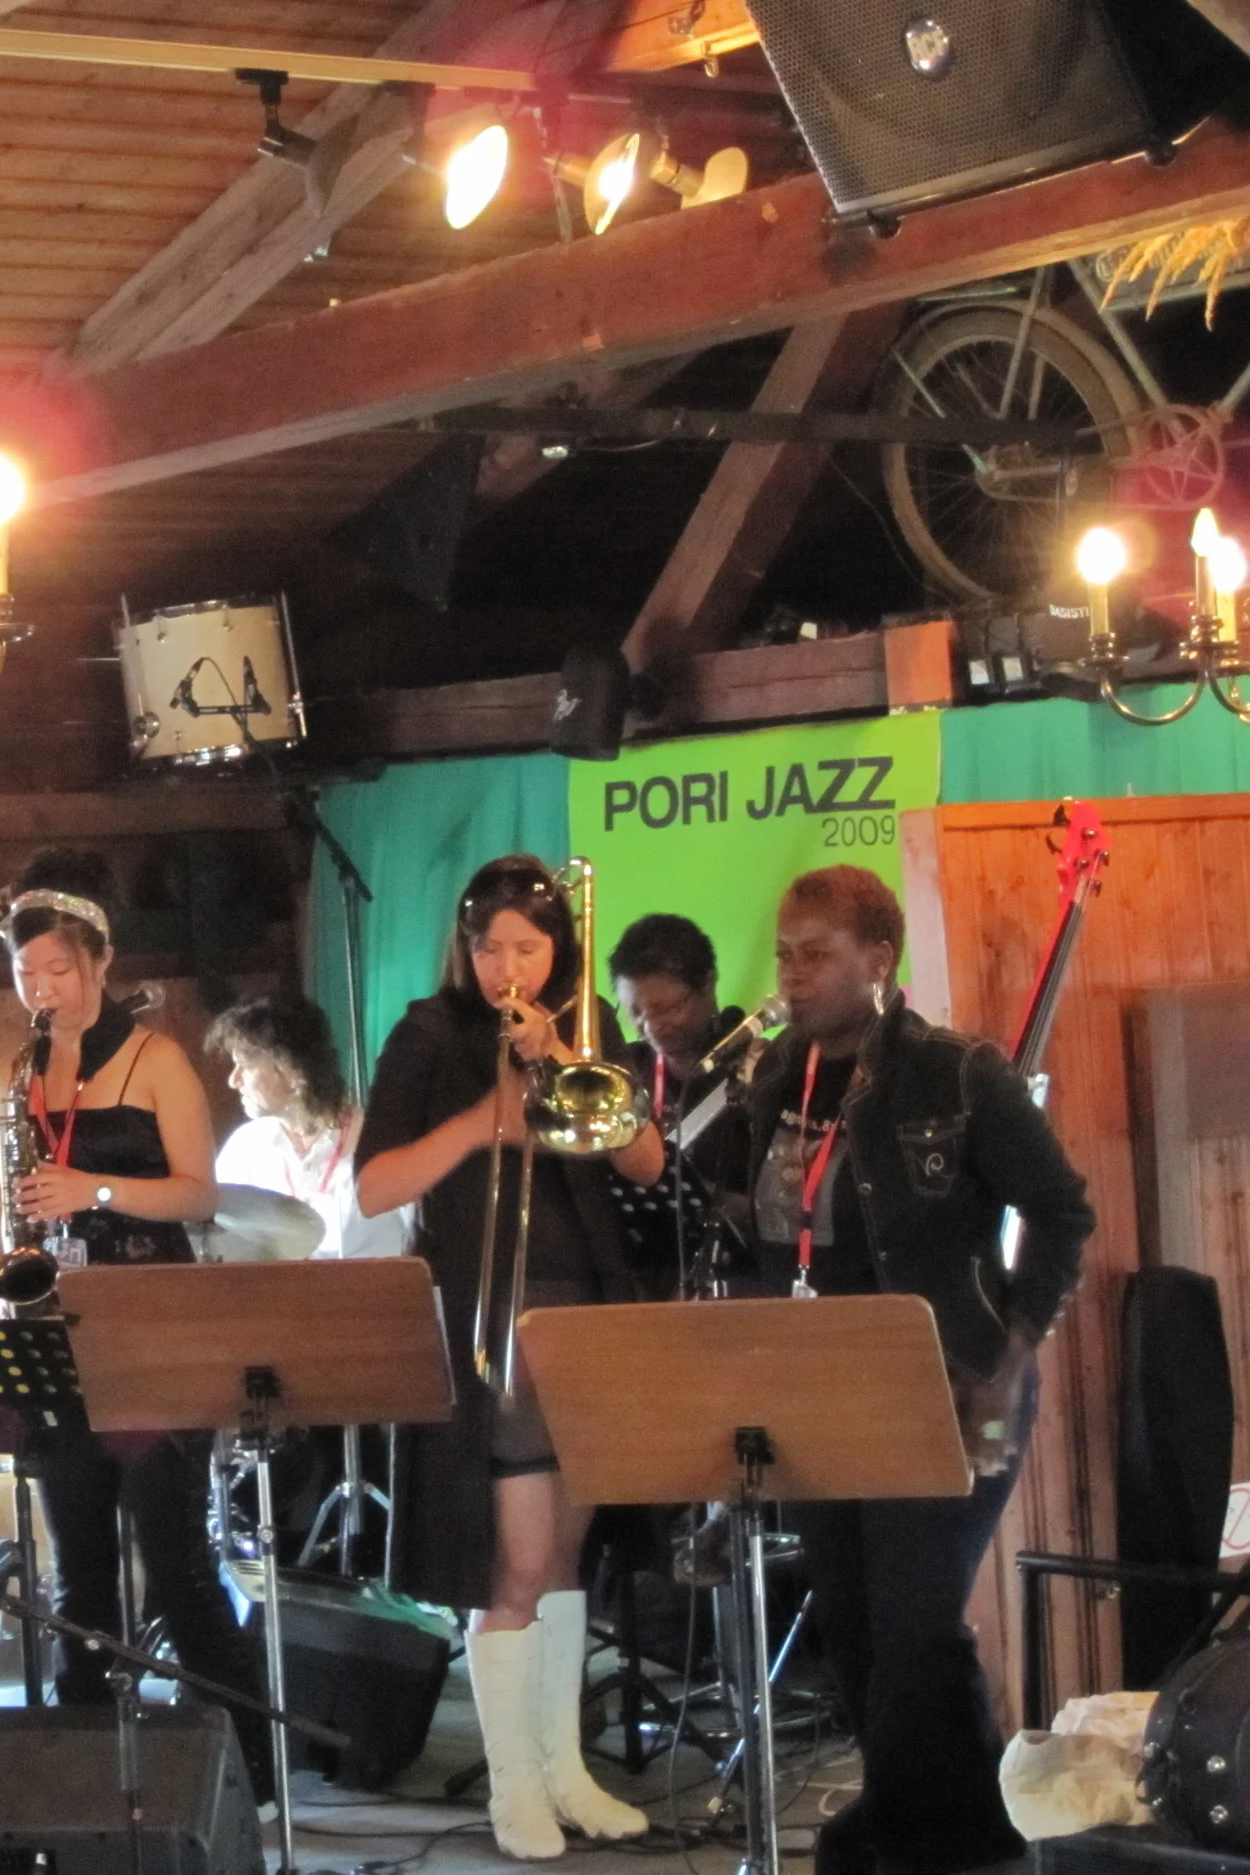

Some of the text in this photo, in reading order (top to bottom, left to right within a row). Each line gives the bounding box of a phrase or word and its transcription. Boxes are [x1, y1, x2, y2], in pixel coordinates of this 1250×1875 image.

[603, 755, 896, 832] PORI JAZZ
[822, 814, 896, 848] 2009
